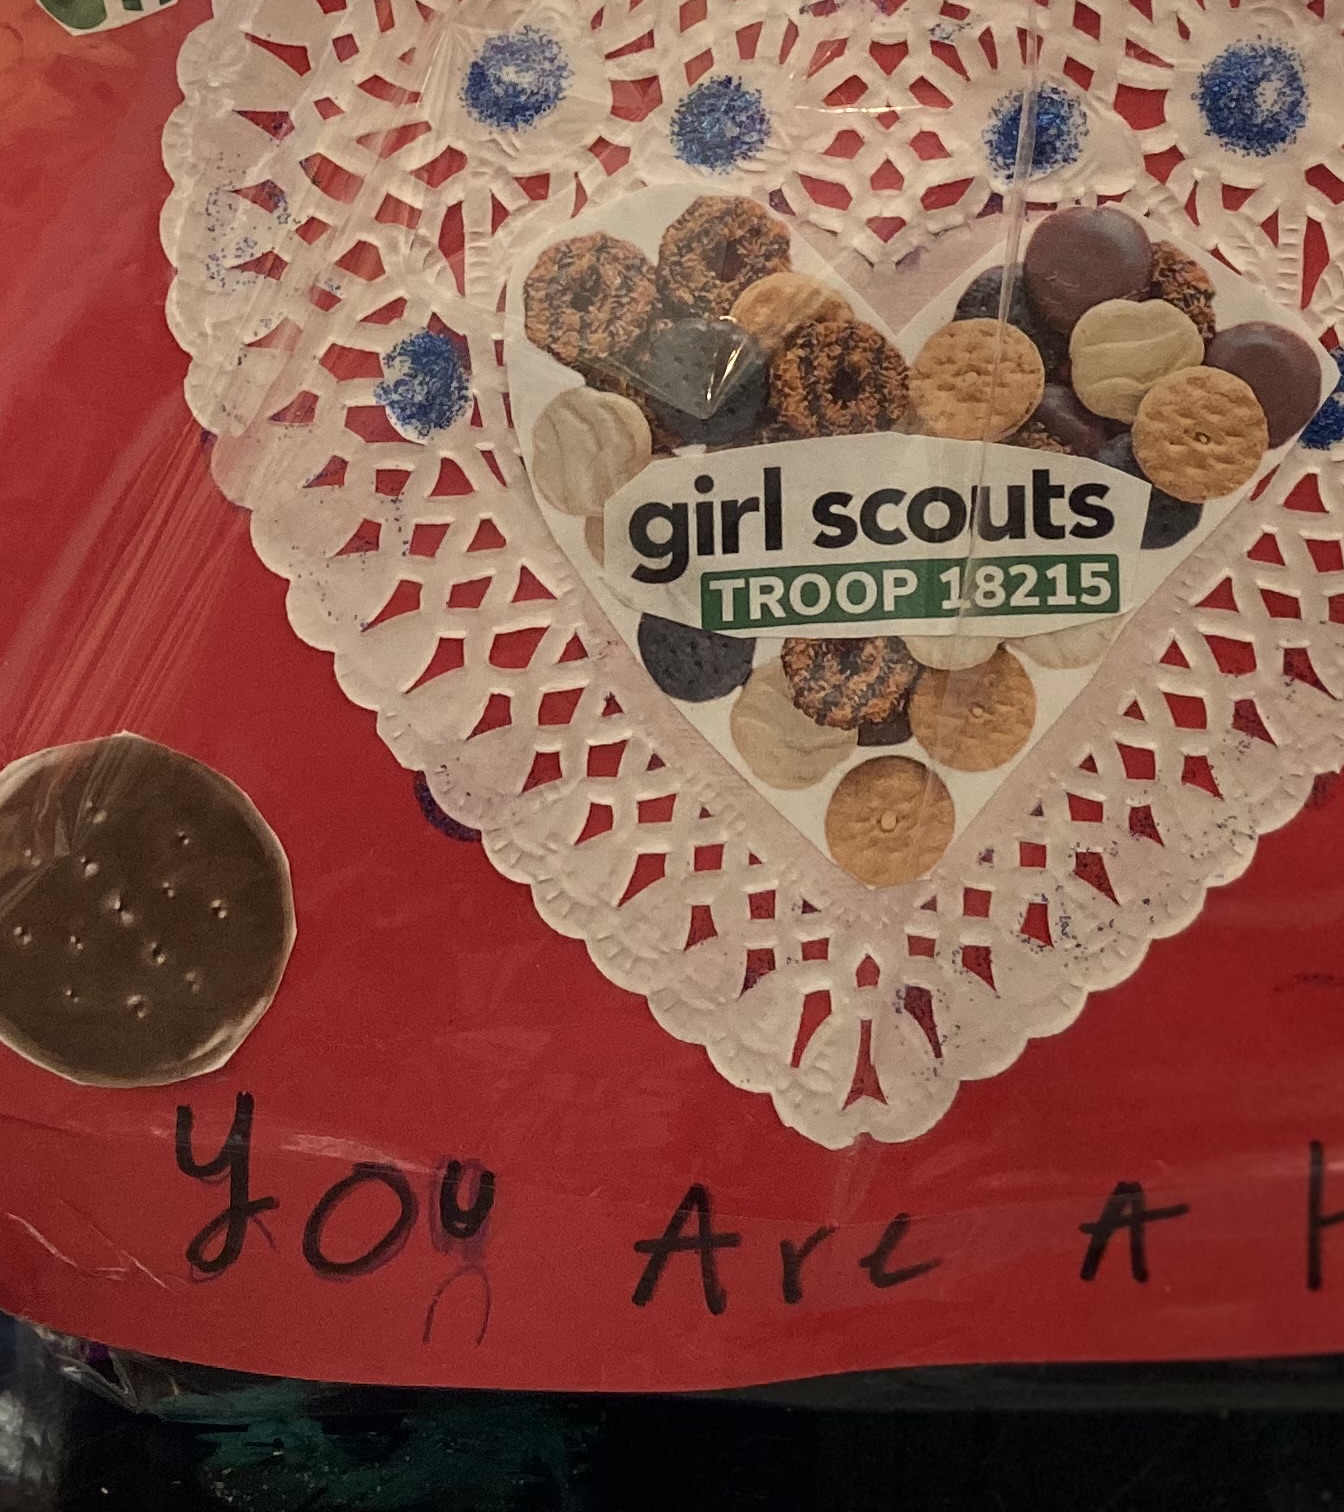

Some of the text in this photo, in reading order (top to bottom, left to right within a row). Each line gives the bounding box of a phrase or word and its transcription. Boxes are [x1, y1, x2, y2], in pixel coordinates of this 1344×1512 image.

[628, 466, 1115, 585] girl scouts
[708, 561, 1113, 623] TROOP 18215
[1081, 1180, 1192, 1285] A
